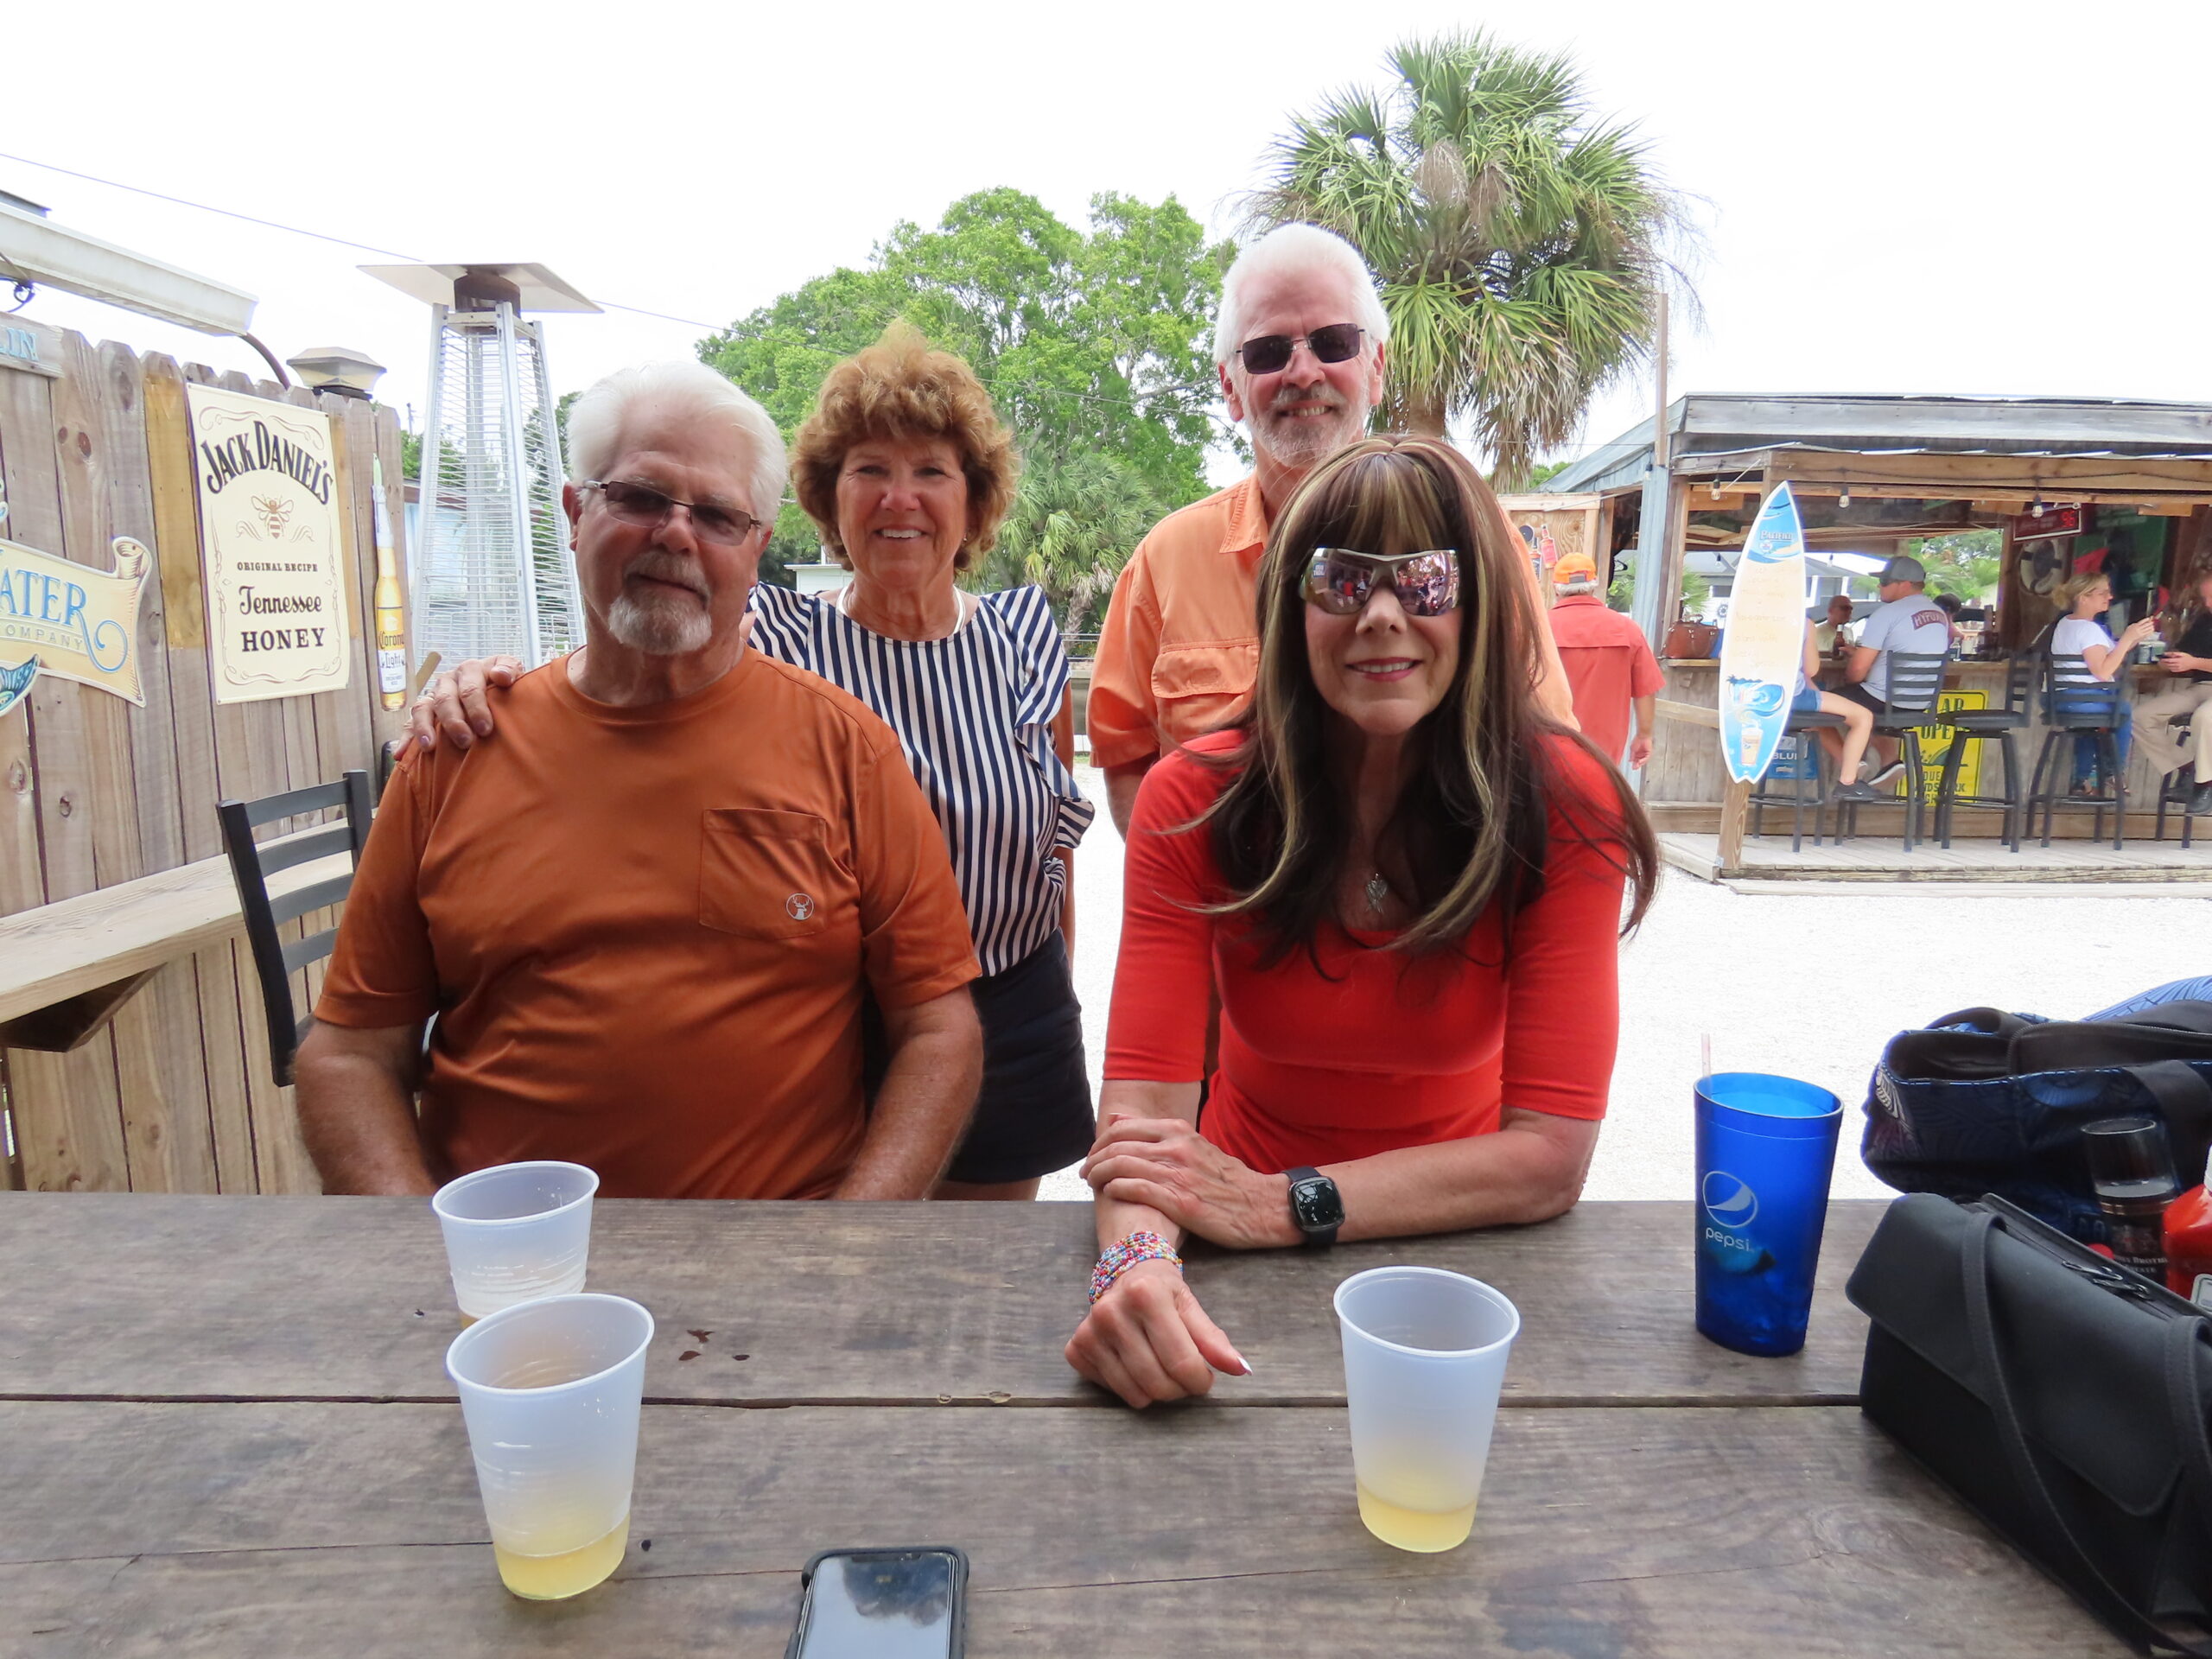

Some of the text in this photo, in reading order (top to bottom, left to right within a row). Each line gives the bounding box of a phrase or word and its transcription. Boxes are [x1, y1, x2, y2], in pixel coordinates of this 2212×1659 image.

[0, 327, 40, 362] IN
[200, 420, 334, 506] JACK DANIEL'S
[237, 562, 319, 573] ORIGINAL RECIPE
[238, 584, 322, 616] Tennessee
[241, 627, 326, 652] HONEY
[1921, 723, 1952, 740] OPE
[1772, 752, 1797, 760] BLU
[1705, 1227, 1750, 1252] pepsi
